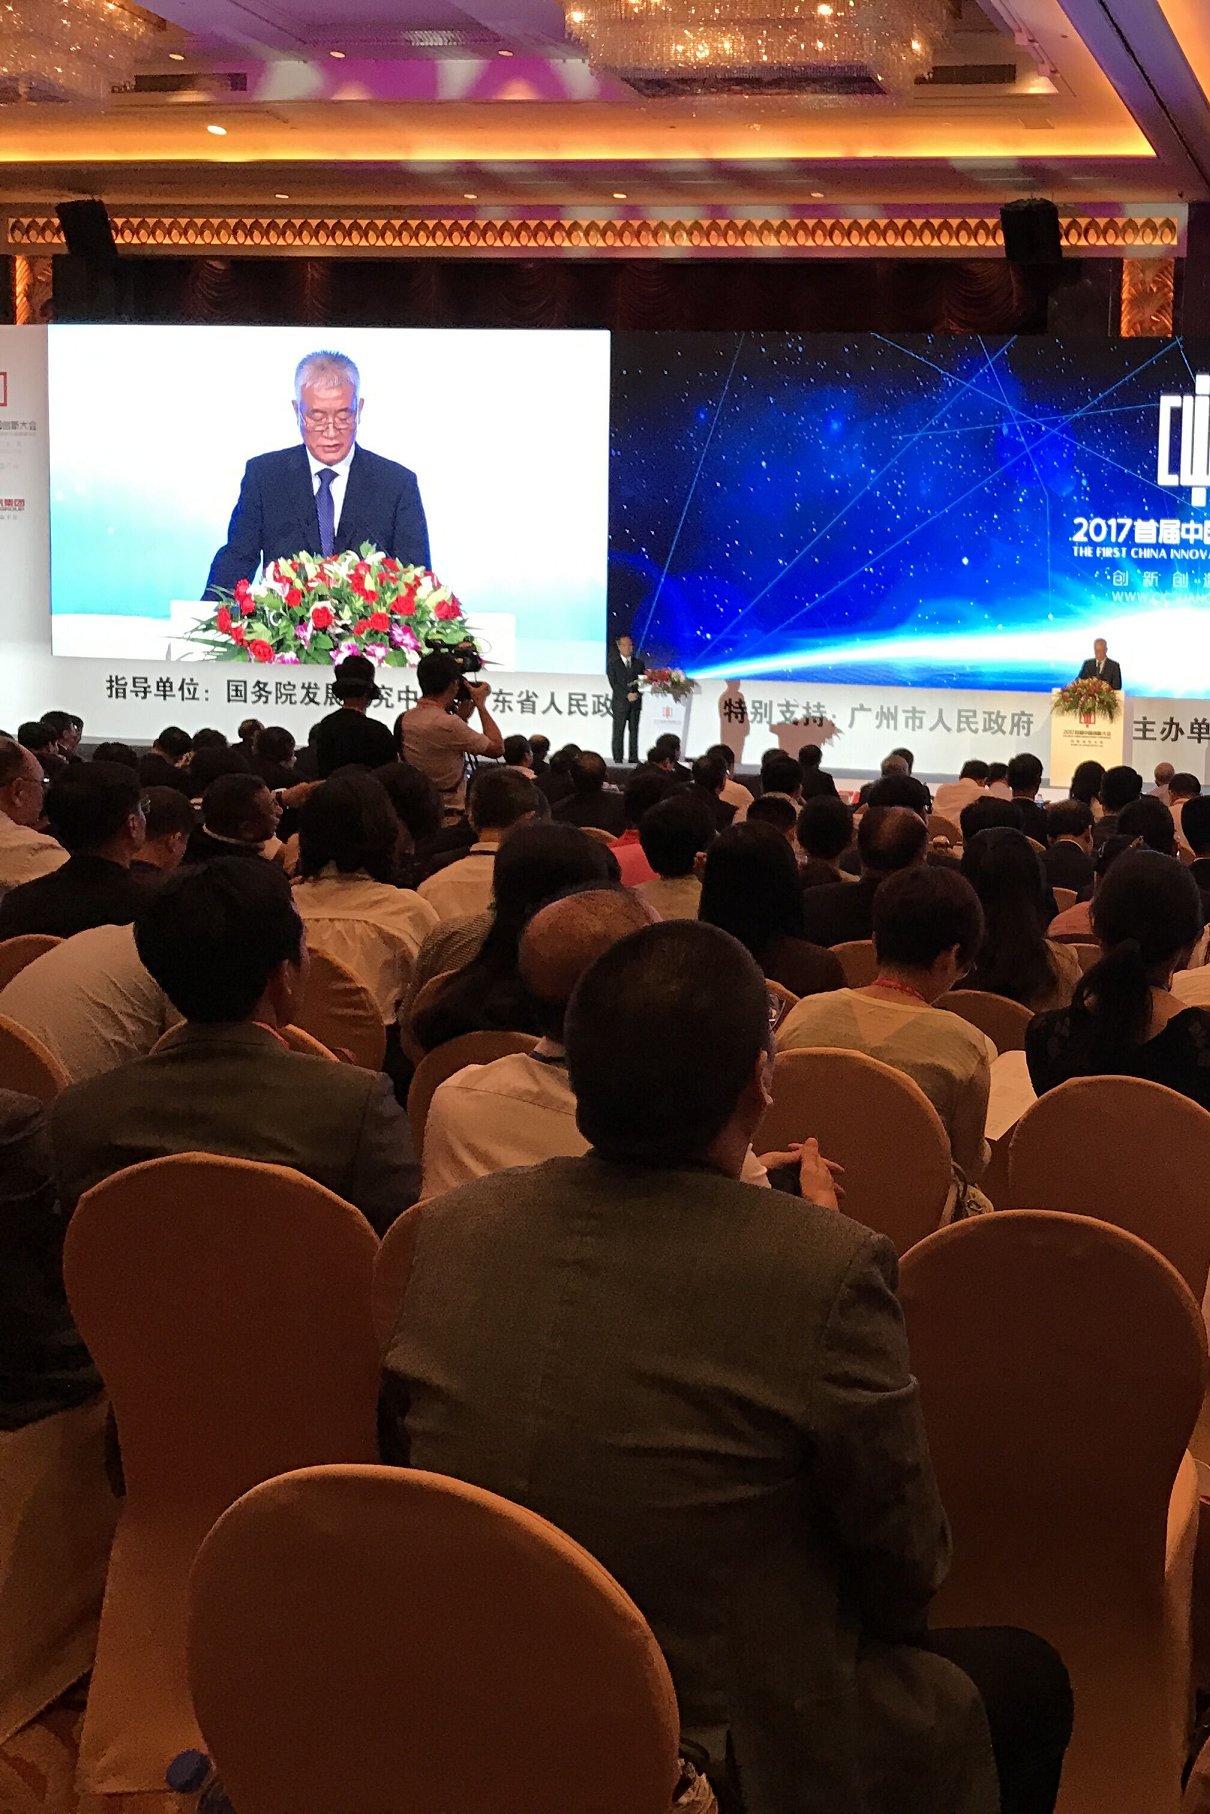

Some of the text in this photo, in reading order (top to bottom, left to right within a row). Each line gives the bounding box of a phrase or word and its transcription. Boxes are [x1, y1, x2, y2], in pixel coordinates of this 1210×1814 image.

[1073, 546, 1093, 557] THE
[1096, 546, 1127, 558] FIRST
[1131, 548, 1167, 560] CHINA
[227, 679, 419, 711] 国务院发展究中
[491, 689, 613, 718] 东省人民政
[848, 703, 1034, 737] 广州市人民政府
